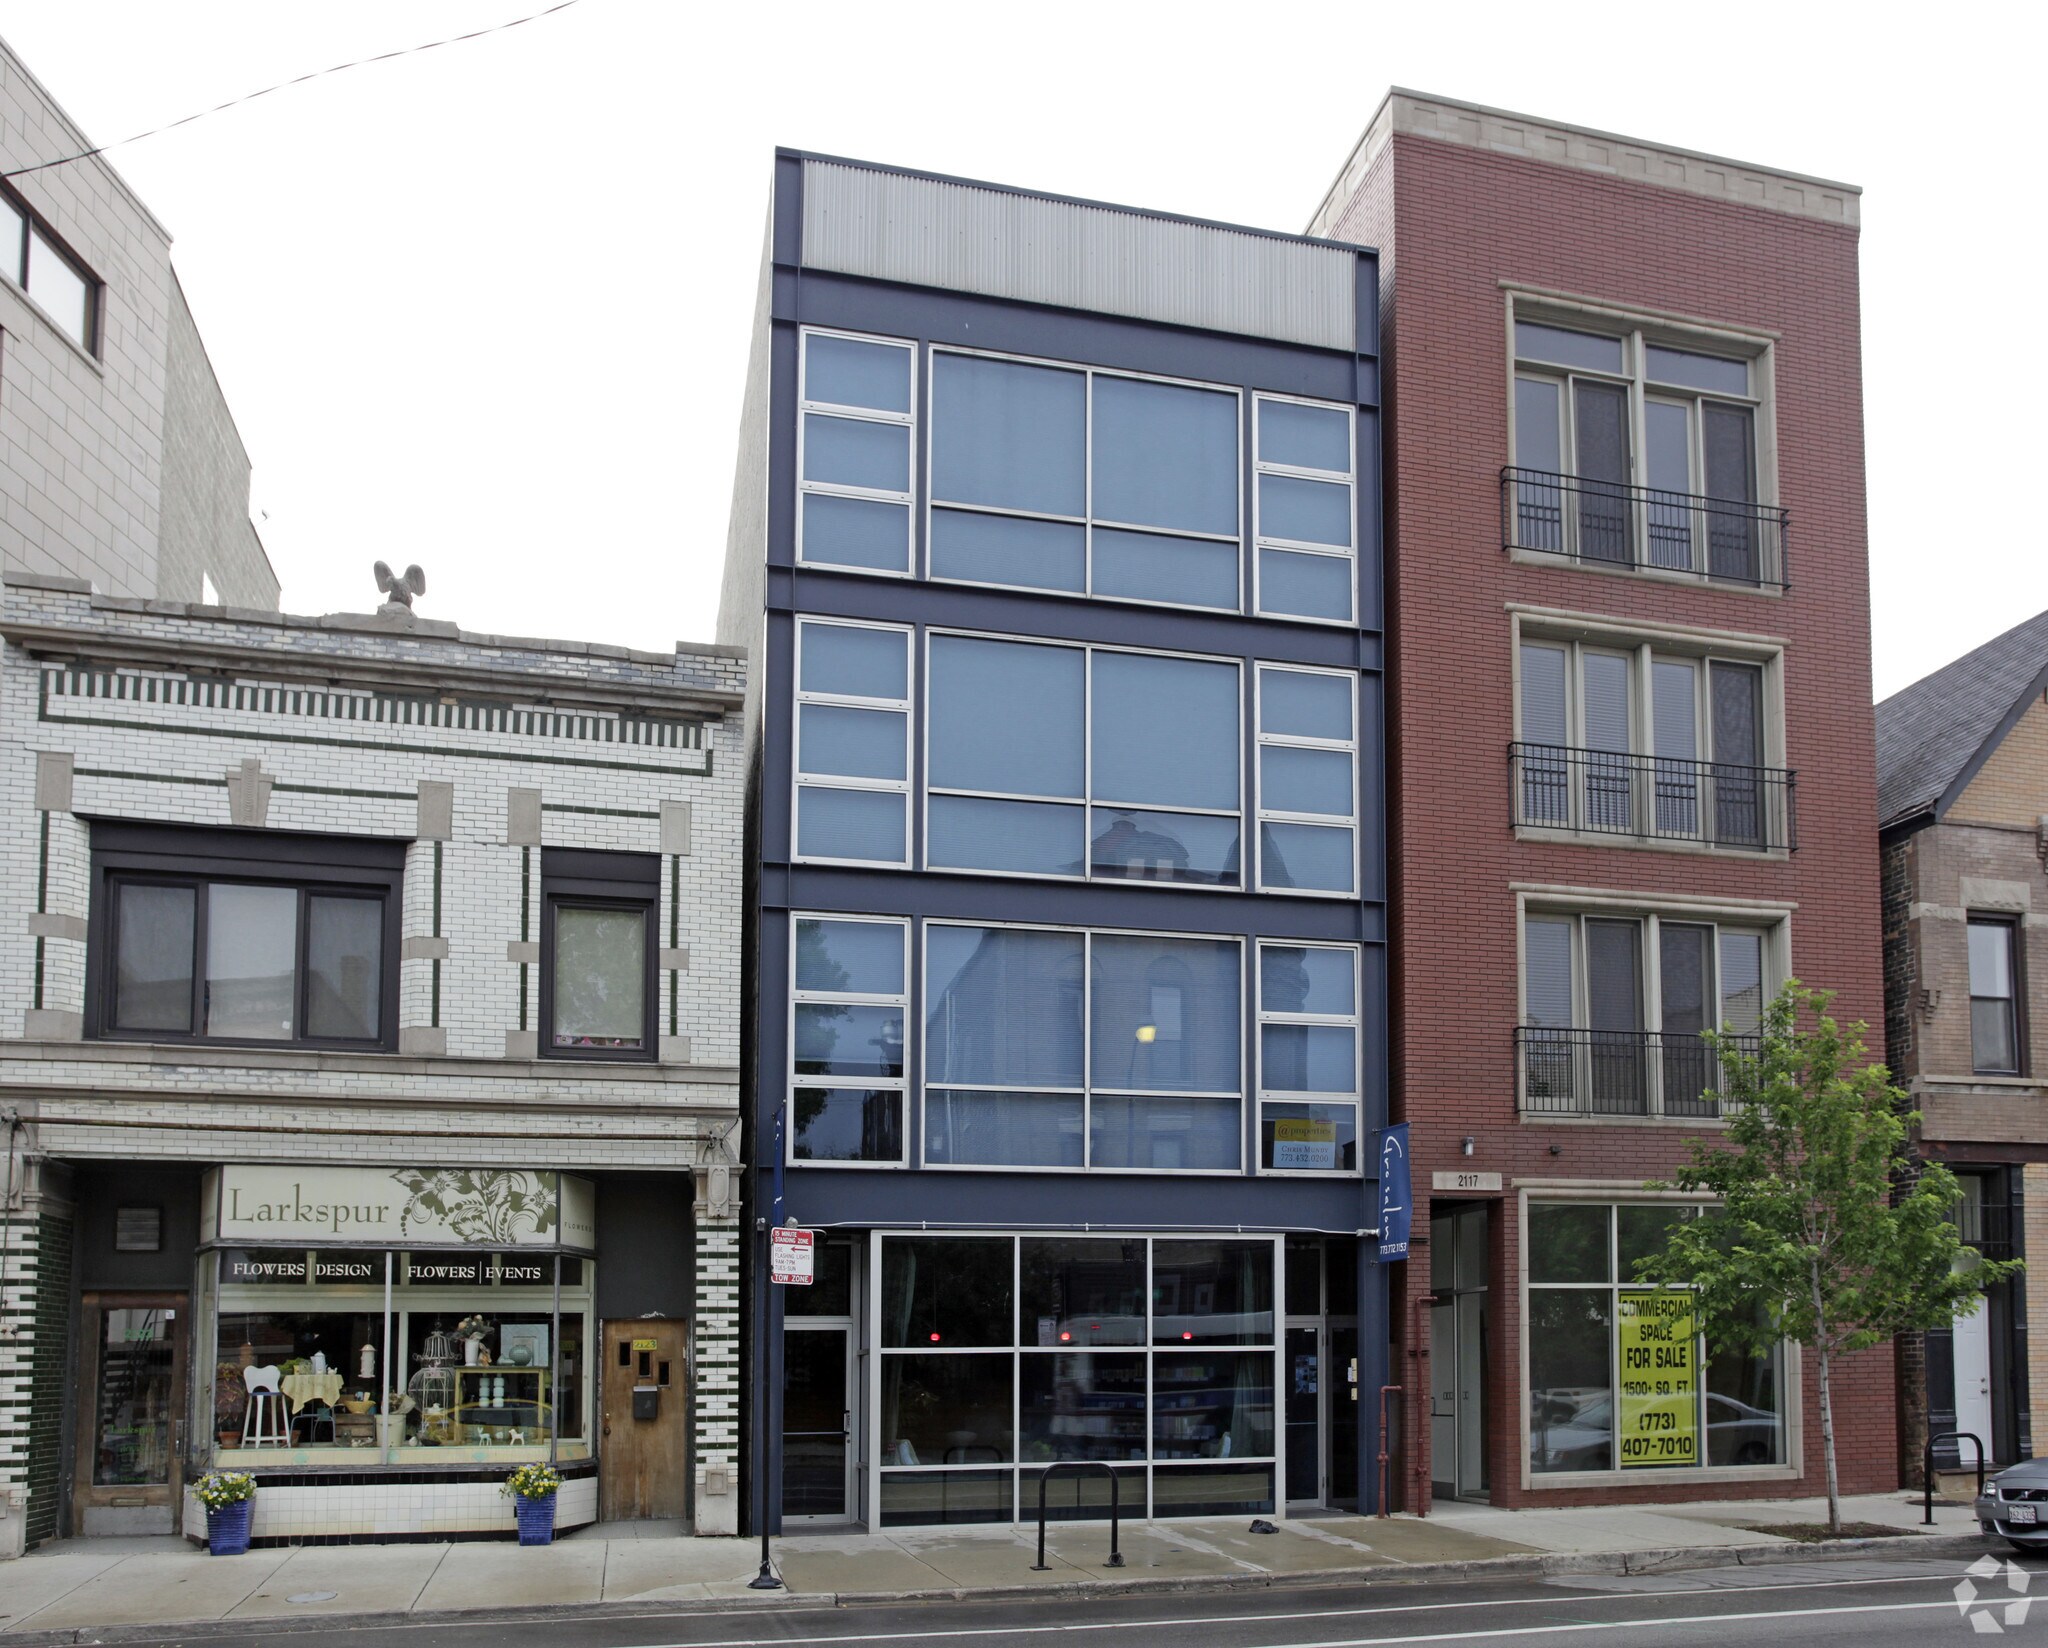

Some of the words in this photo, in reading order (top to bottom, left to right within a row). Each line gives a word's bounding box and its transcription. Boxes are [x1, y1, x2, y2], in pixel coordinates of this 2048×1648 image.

[1458, 1174, 1479, 1187] 2117
[228, 1183, 389, 1233] Larkspur
[564, 1222, 592, 1233] FLOWERS
[233, 1262, 305, 1276] FLOWERS
[315, 1263, 372, 1277] DESIGN
[407, 1265, 476, 1278] FLOWERS
[485, 1266, 541, 1279] EVENTS
[775, 1274, 789, 1282] TOW
[791, 1274, 809, 1283] ZONE
[1640, 1324, 1673, 1341] SPACE
[1627, 1347, 1650, 1369] FOR
[1655, 1347, 1687, 1368] SALE
[1623, 1381, 1652, 1396] 1500+
[1656, 1380, 1673, 1396] SQ.
[1677, 1380, 1691, 1396] FT.
[1639, 1412, 1676, 1431] (773)
[1622, 1436, 1692, 1456] 407-7010
